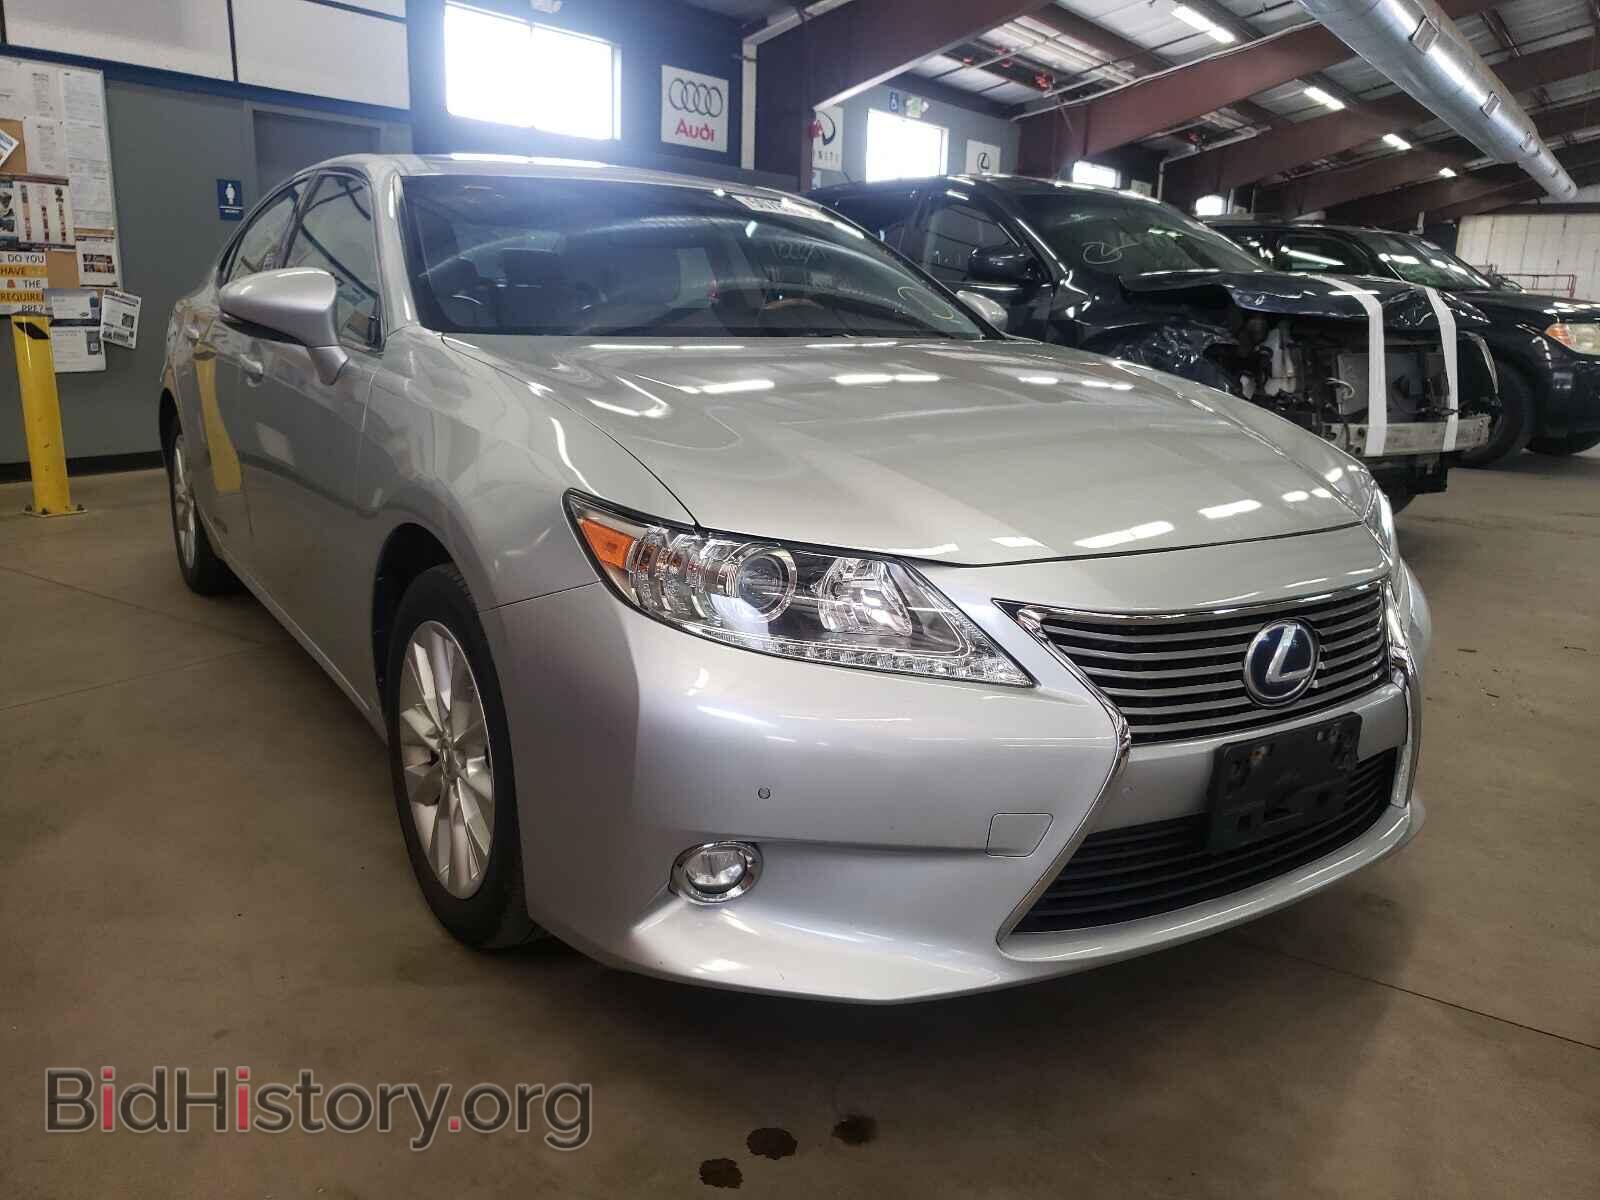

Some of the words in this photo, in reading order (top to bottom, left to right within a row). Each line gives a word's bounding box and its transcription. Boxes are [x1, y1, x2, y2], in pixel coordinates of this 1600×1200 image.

[674, 118, 714, 142] Audi
[7, 253, 22, 263] DO
[24, 254, 46, 264] YOU
[23, 279, 41, 289] THE
